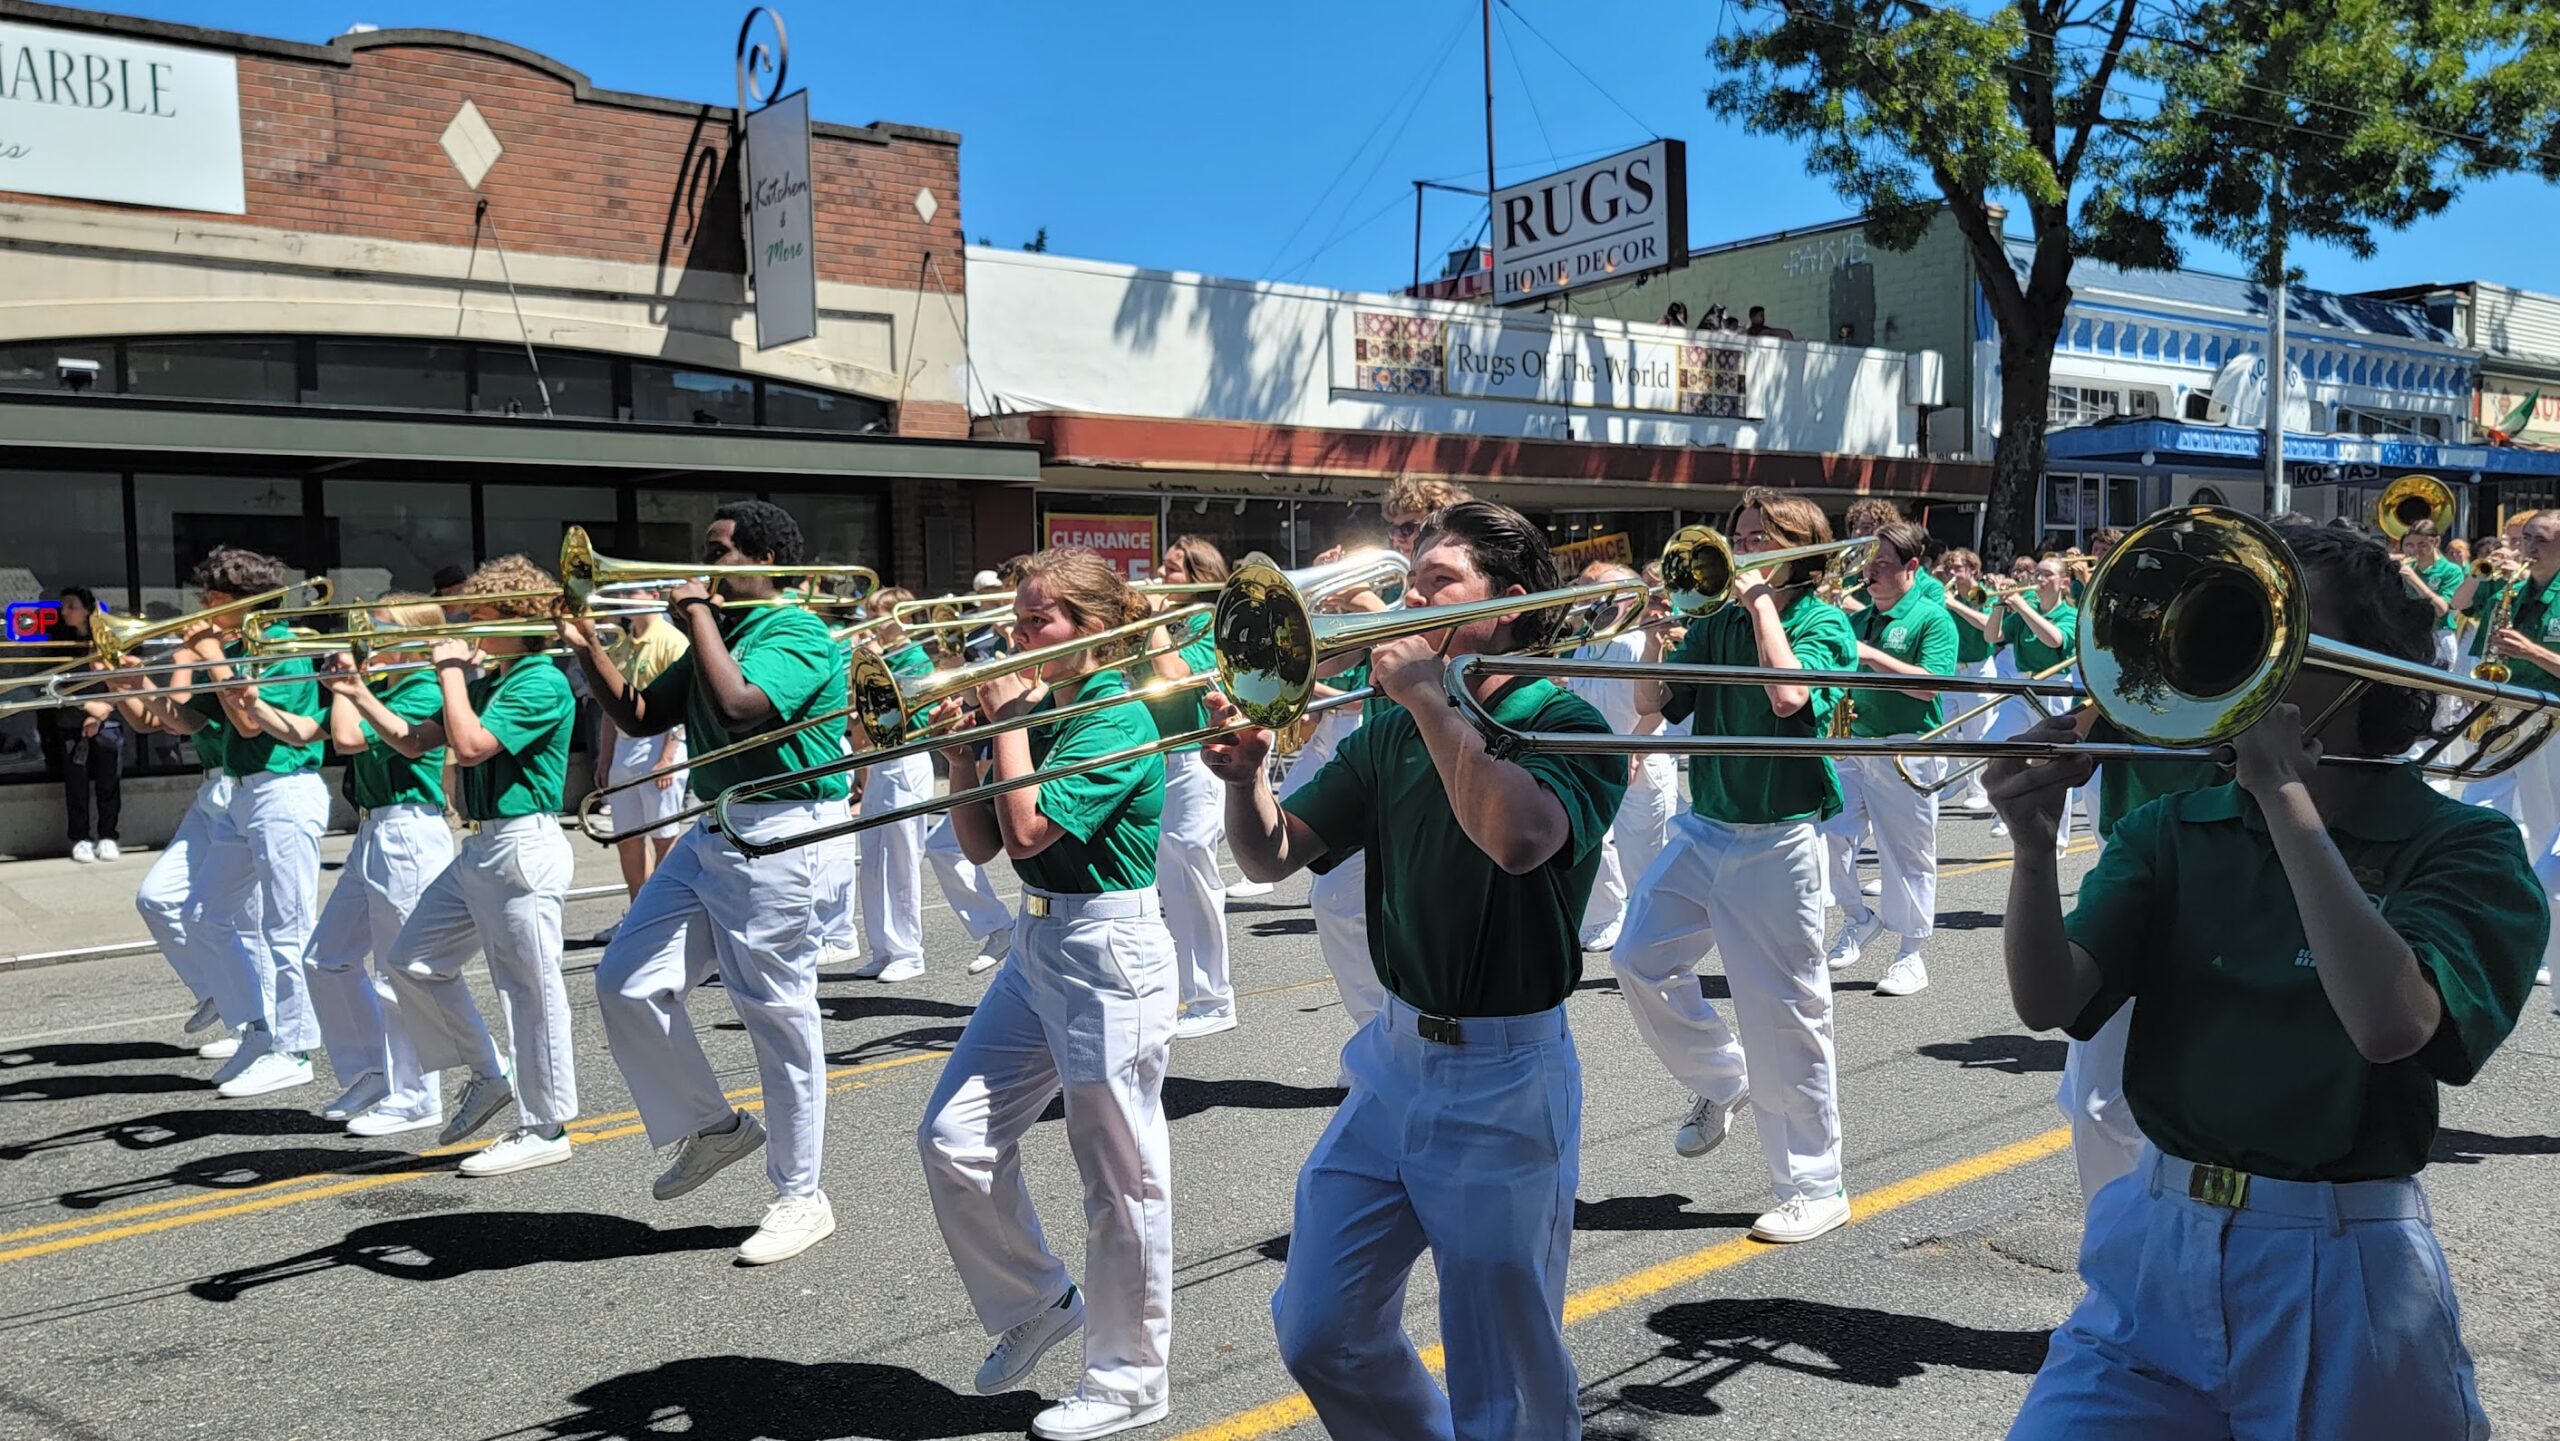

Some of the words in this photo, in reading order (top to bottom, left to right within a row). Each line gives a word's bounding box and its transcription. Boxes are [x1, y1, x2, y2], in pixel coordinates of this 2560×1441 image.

[0, 43, 176, 118] ARBLE
[755, 170, 807, 211] Kitchen
[1501, 156, 1653, 250] RUGS
[765, 239, 802, 267] More
[1505, 258, 1568, 293] HOME
[1577, 236, 1657, 276] DECOR
[1457, 344, 1515, 386] Rugs
[1522, 349, 1551, 379] Of
[1556, 353, 1598, 383] The
[1604, 357, 1670, 389] World
[1051, 530, 1151, 550] CLEARANCE
[13, 607, 59, 637] OP
